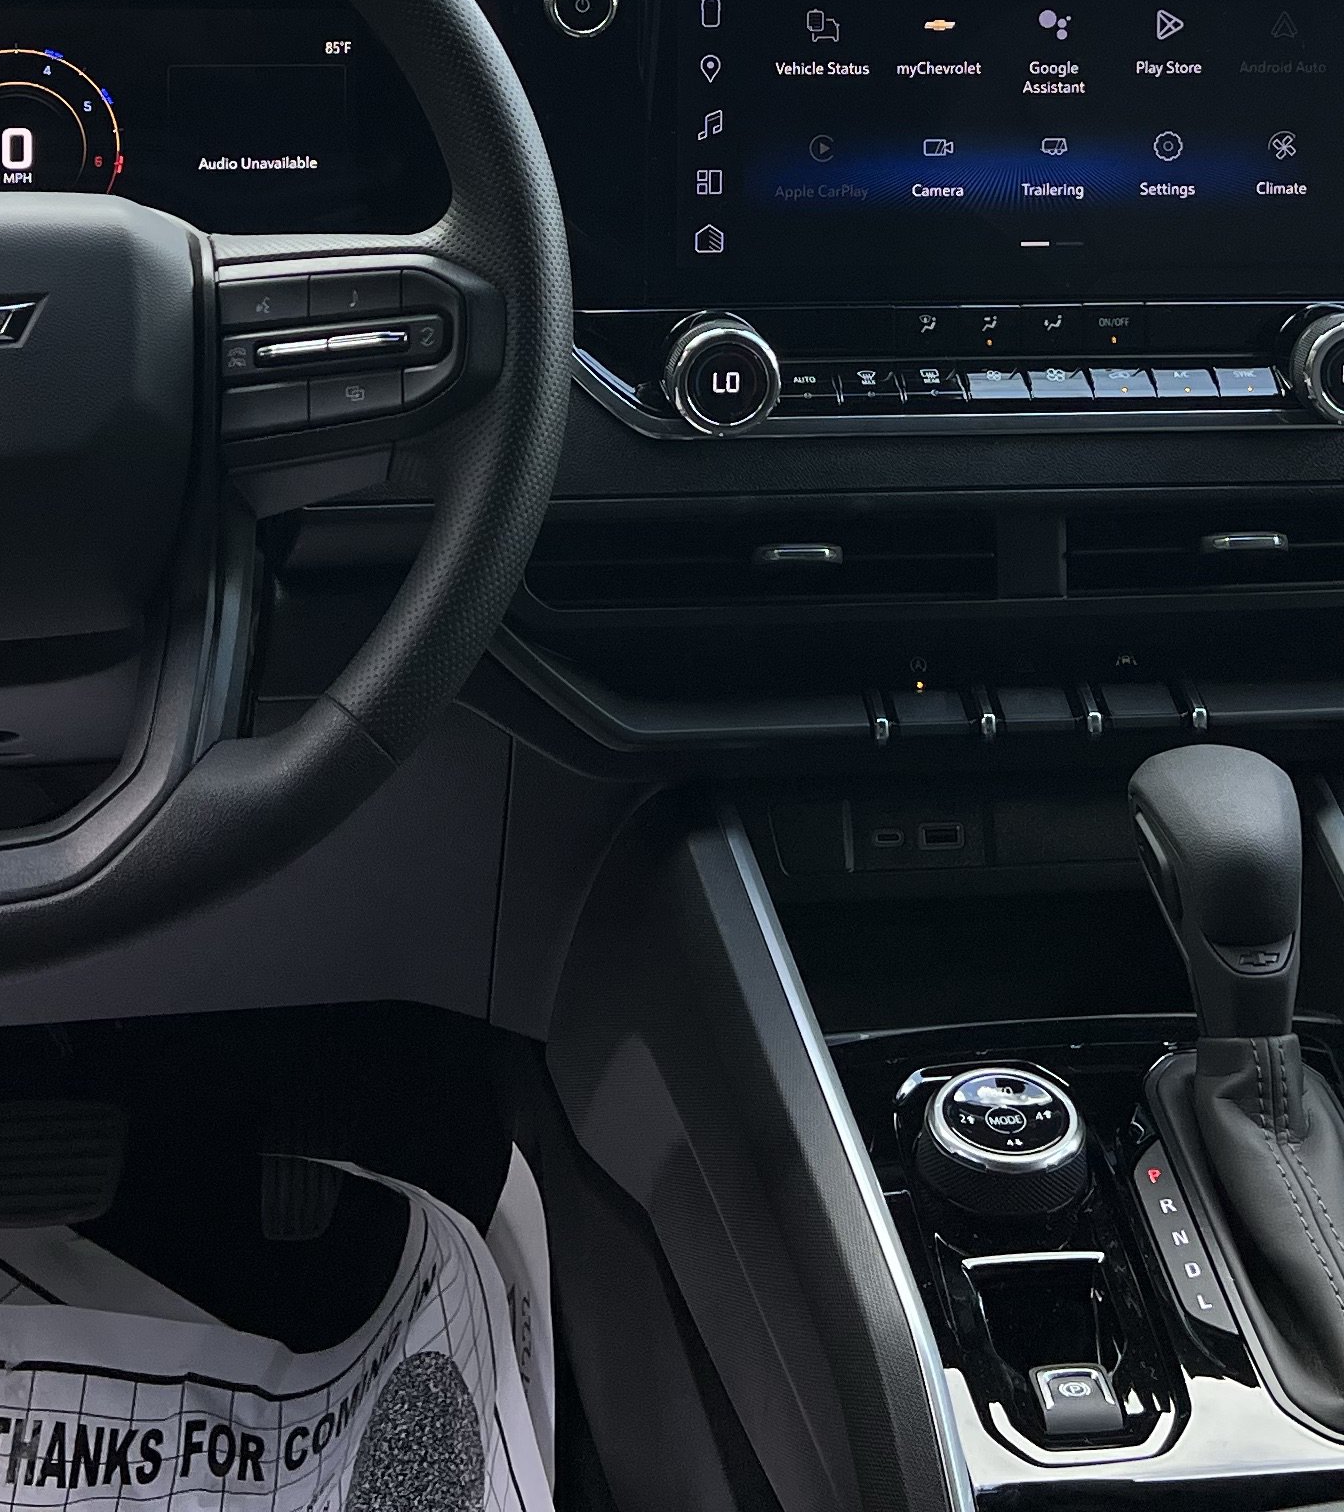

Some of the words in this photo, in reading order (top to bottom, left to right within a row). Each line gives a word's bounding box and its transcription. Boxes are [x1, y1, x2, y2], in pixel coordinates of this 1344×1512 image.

[325, 41, 352, 54] 85°F
[43, 65, 52, 76] 4
[775, 61, 824, 76] Vehicle
[828, 61, 870, 75] Status
[896, 61, 982, 78] myChevrolet
[1029, 60, 1079, 77] Google
[1136, 60, 1163, 77] Play
[1166, 60, 1202, 74] Store
[1239, 61, 1292, 74] Android
[1296, 61, 1327, 74] Auto
[1022, 81, 1086, 94] Assistant
[83, 101, 92, 112] 5
[1, 128, 33, 169] 0
[94, 156, 103, 167] 6
[198, 157, 238, 170] Audio
[240, 156, 318, 170] Unavailable
[3, 173, 32, 184] MPH
[774, 185, 814, 201] Apple
[818, 185, 869, 201] CarPlay
[911, 184, 965, 197] Camera
[1021, 182, 1084, 200] Trailering
[1139, 181, 1196, 199] Settings
[1256, 181, 1307, 196] Climate
[1098, 317, 1131, 328] ON/OFF
[712, 371, 741, 393] LO
[793, 375, 816, 384] AUTO
[988, 1115, 1023, 1126] MODE
[1147, 1169, 1161, 1183] P
[1159, 1199, 1177, 1214] R
[1171, 1230, 1189, 1246] N
[1184, 1262, 1201, 1278] D
[1196, 1294, 1212, 1310] L
[180, 1419, 265, 1481] FOR
